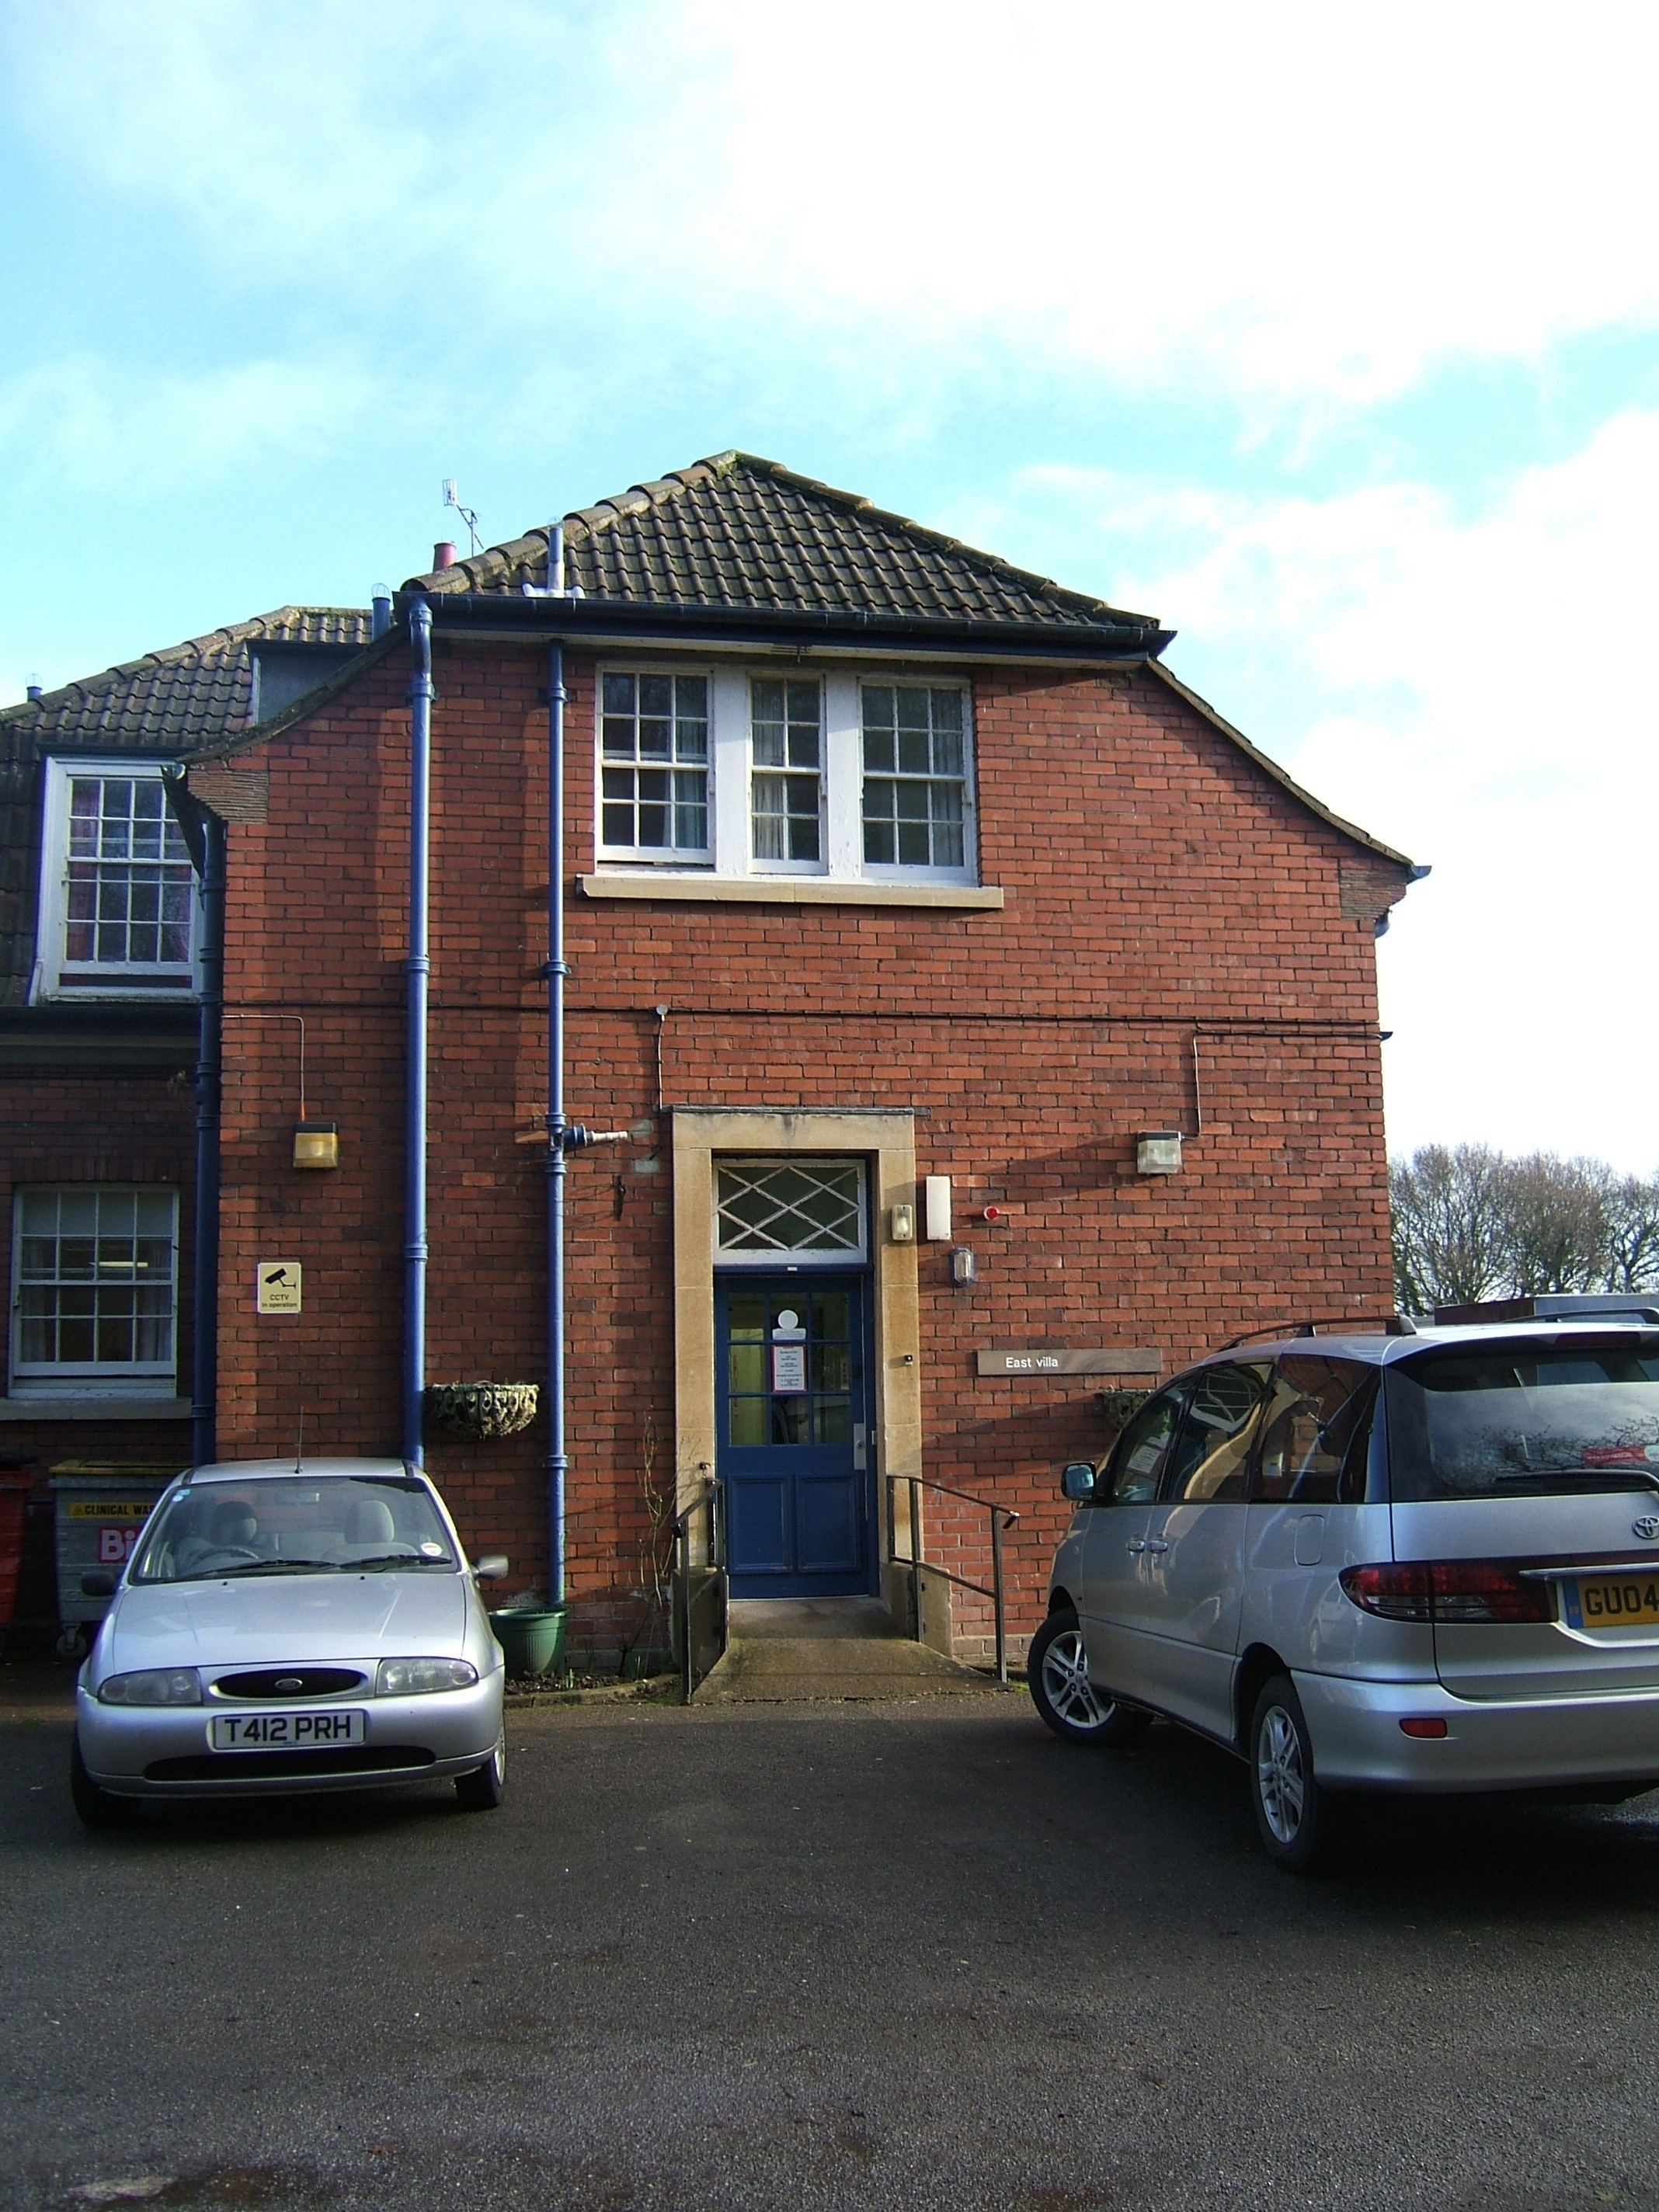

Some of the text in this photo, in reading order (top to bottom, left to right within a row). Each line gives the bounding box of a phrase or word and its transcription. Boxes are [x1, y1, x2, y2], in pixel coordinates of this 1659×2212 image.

[1006, 1357, 1059, 1369] East villa
[85, 1504, 129, 1515] CLINICAL
[224, 1715, 351, 1742] T412 PRH
